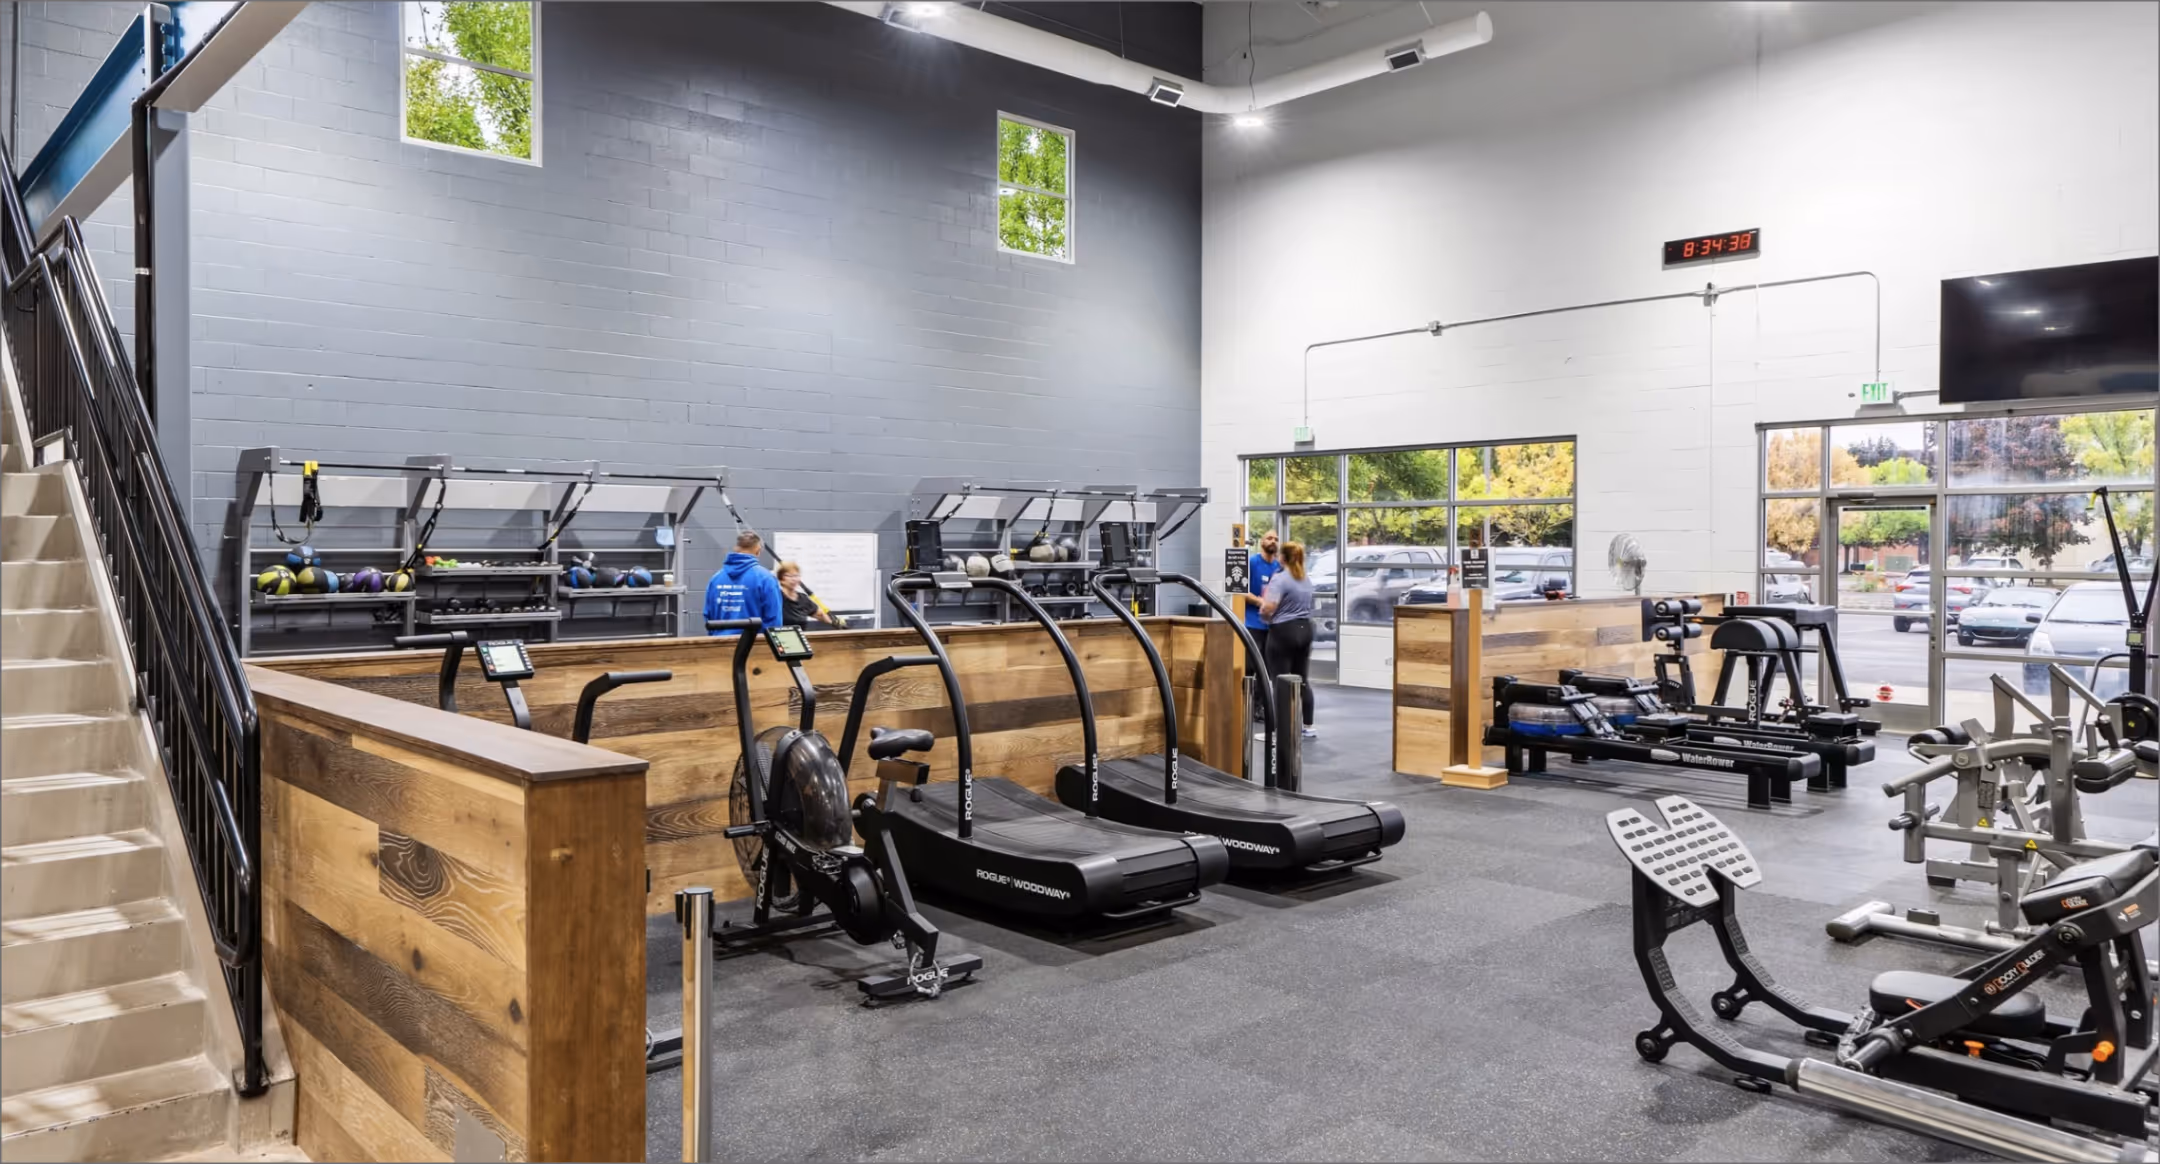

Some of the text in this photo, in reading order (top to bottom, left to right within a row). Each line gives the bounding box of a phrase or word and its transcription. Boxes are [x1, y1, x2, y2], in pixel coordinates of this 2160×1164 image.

[1862, 383, 1888, 401] EXIT
[1749, 680, 1757, 721] ROGUE
[1682, 753, 1735, 768] WaterRower
